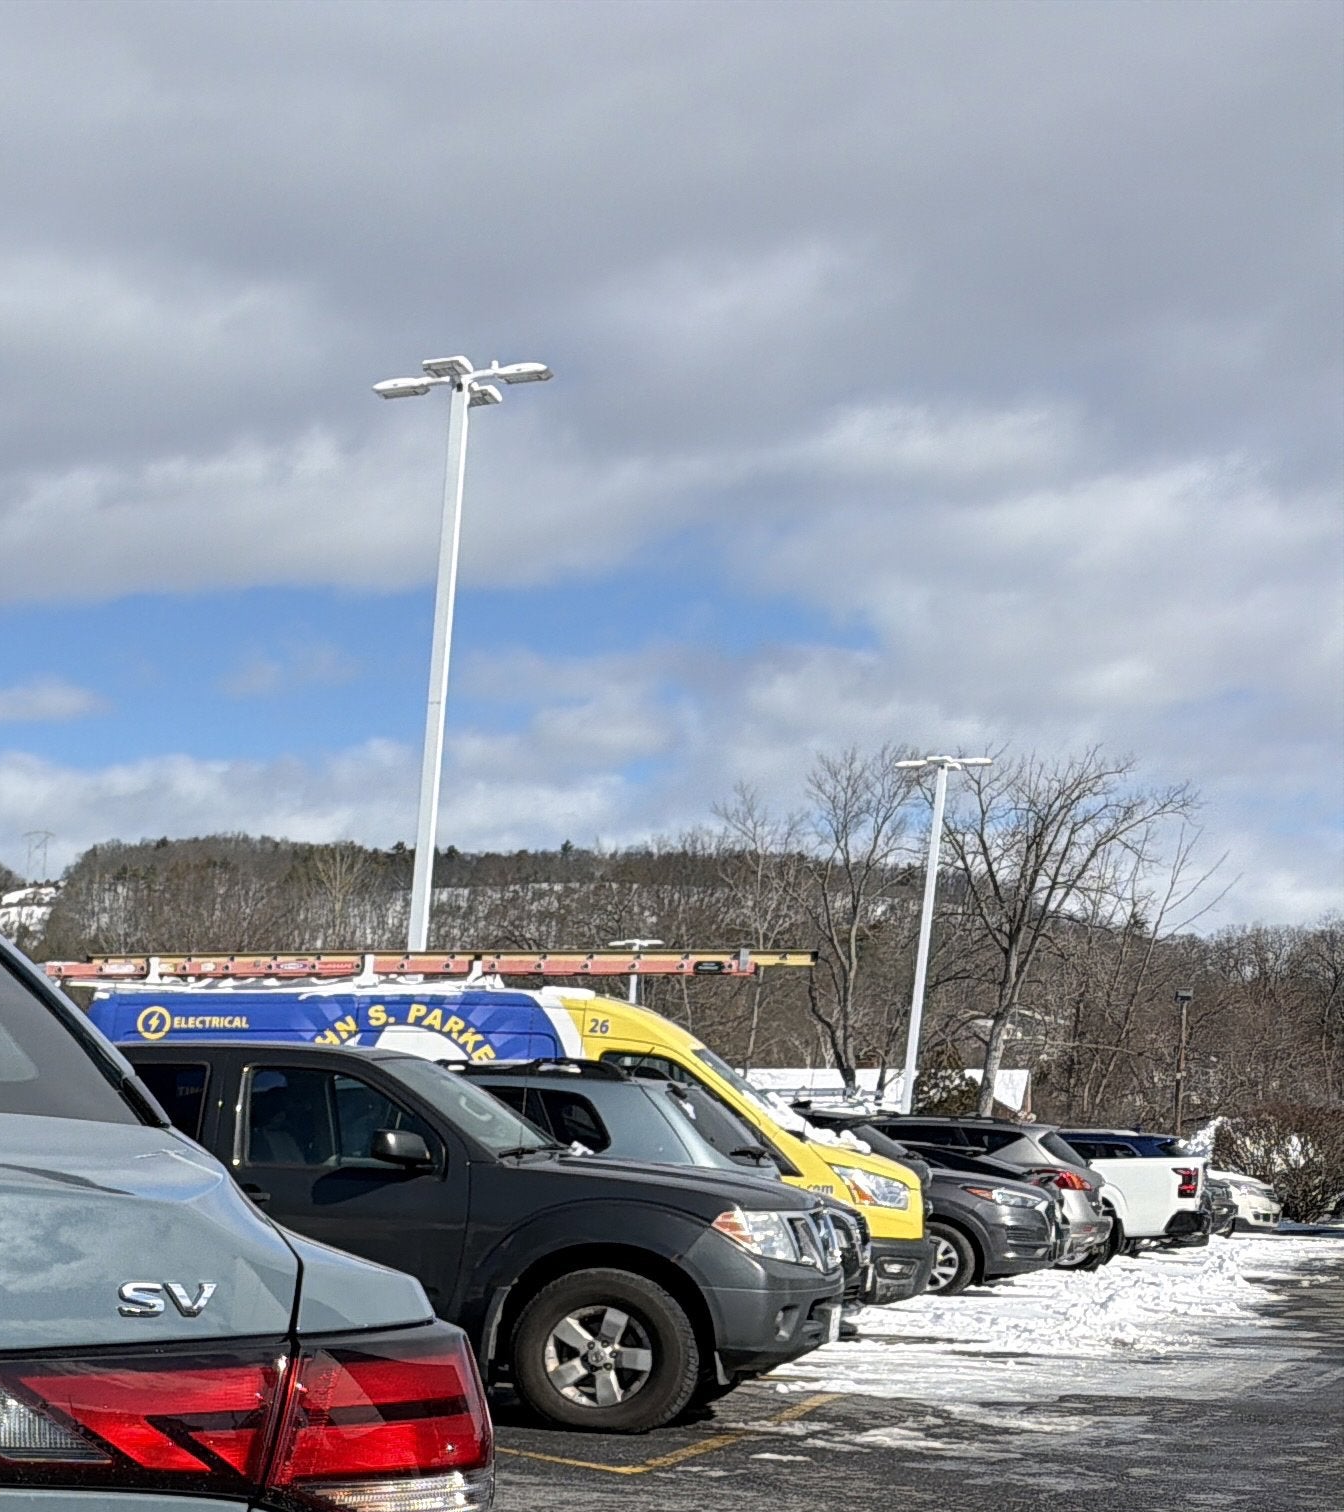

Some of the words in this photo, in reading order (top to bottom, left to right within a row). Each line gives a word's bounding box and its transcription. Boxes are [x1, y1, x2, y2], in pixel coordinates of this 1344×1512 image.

[173, 1016, 249, 1029] ELECTRICAL
[368, 1004, 395, 1027] S.
[589, 1018, 610, 1034] 26
[115, 1280, 217, 1318] SV
